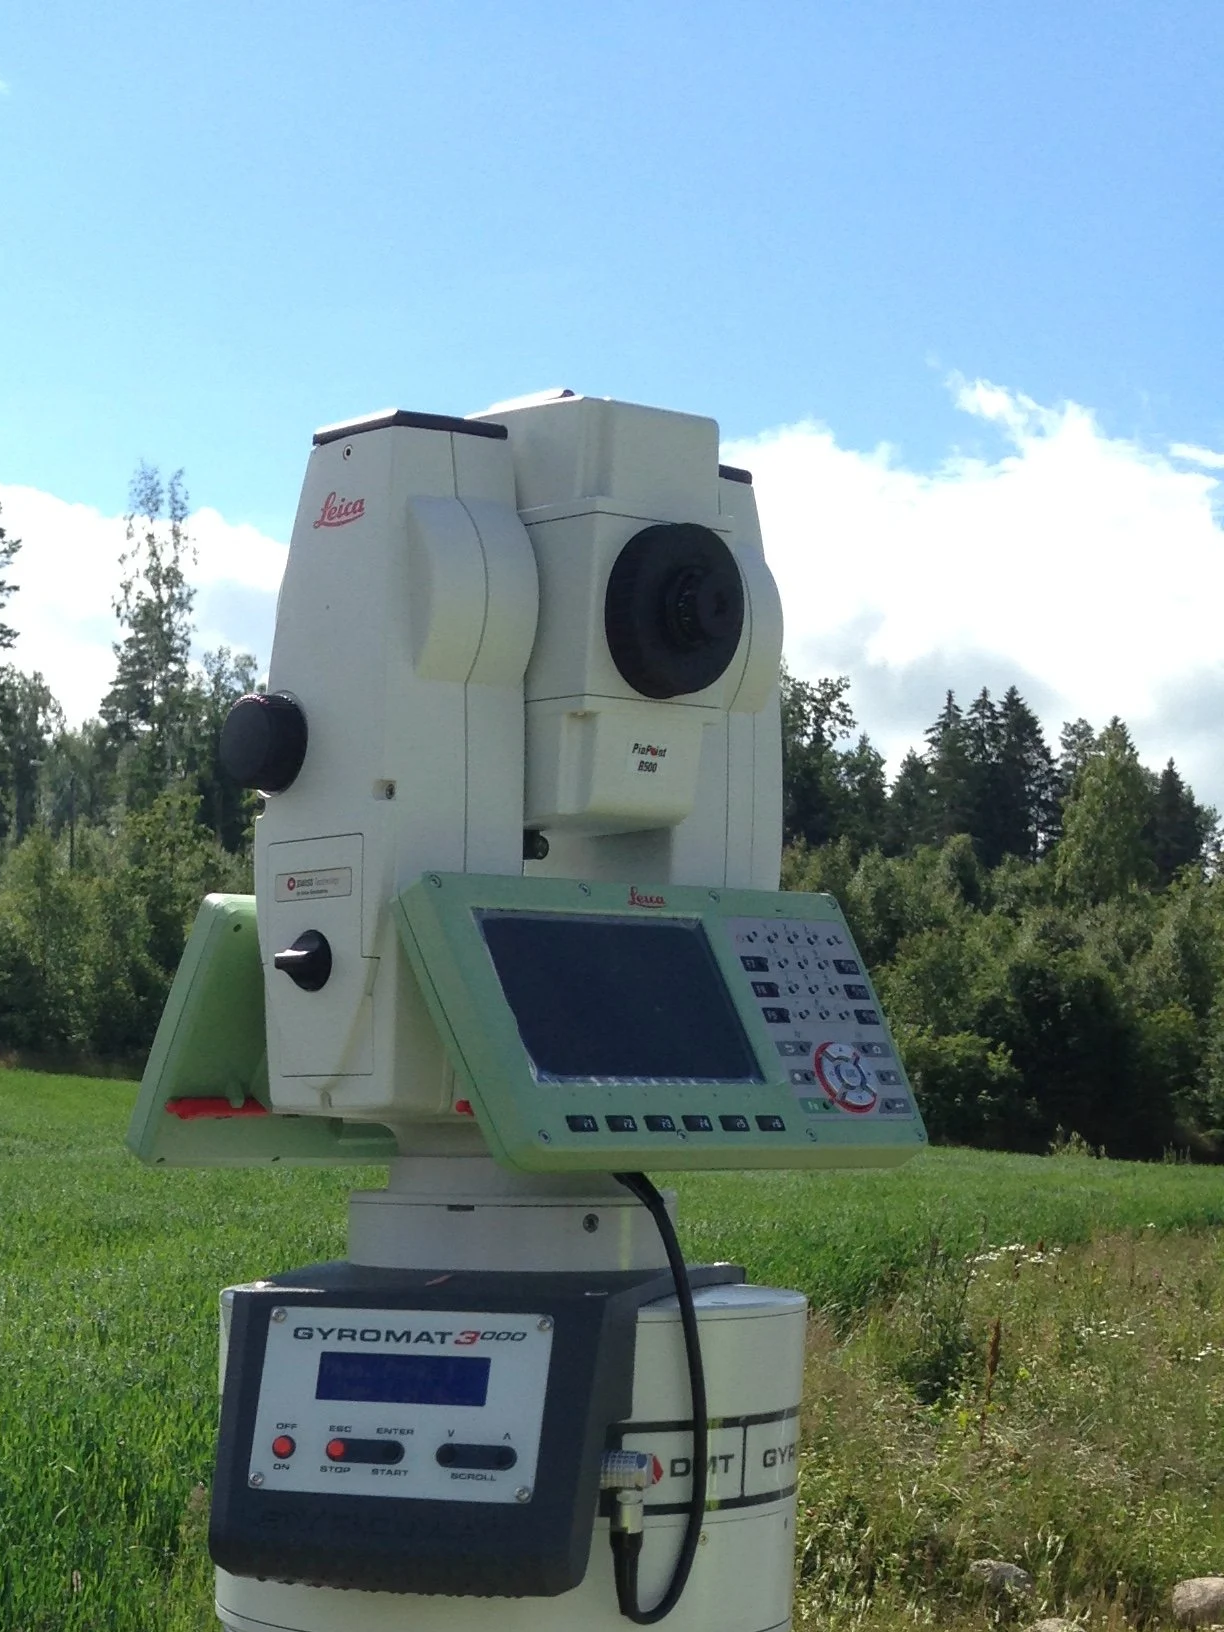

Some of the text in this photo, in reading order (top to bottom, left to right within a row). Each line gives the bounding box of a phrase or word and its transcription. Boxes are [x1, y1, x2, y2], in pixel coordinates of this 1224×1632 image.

[313, 491, 365, 529] Leica
[628, 886, 665, 909] Leica
[293, 1326, 528, 1346] GYROMAT 3000
[276, 1422, 299, 1431] OFF
[328, 1424, 353, 1434] ESC
[375, 1426, 415, 1436] ENTER
[272, 1463, 291, 1471] ON
[319, 1464, 352, 1474] STOP
[371, 1467, 409, 1478] START
[450, 1472, 498, 1483] SCROLL
